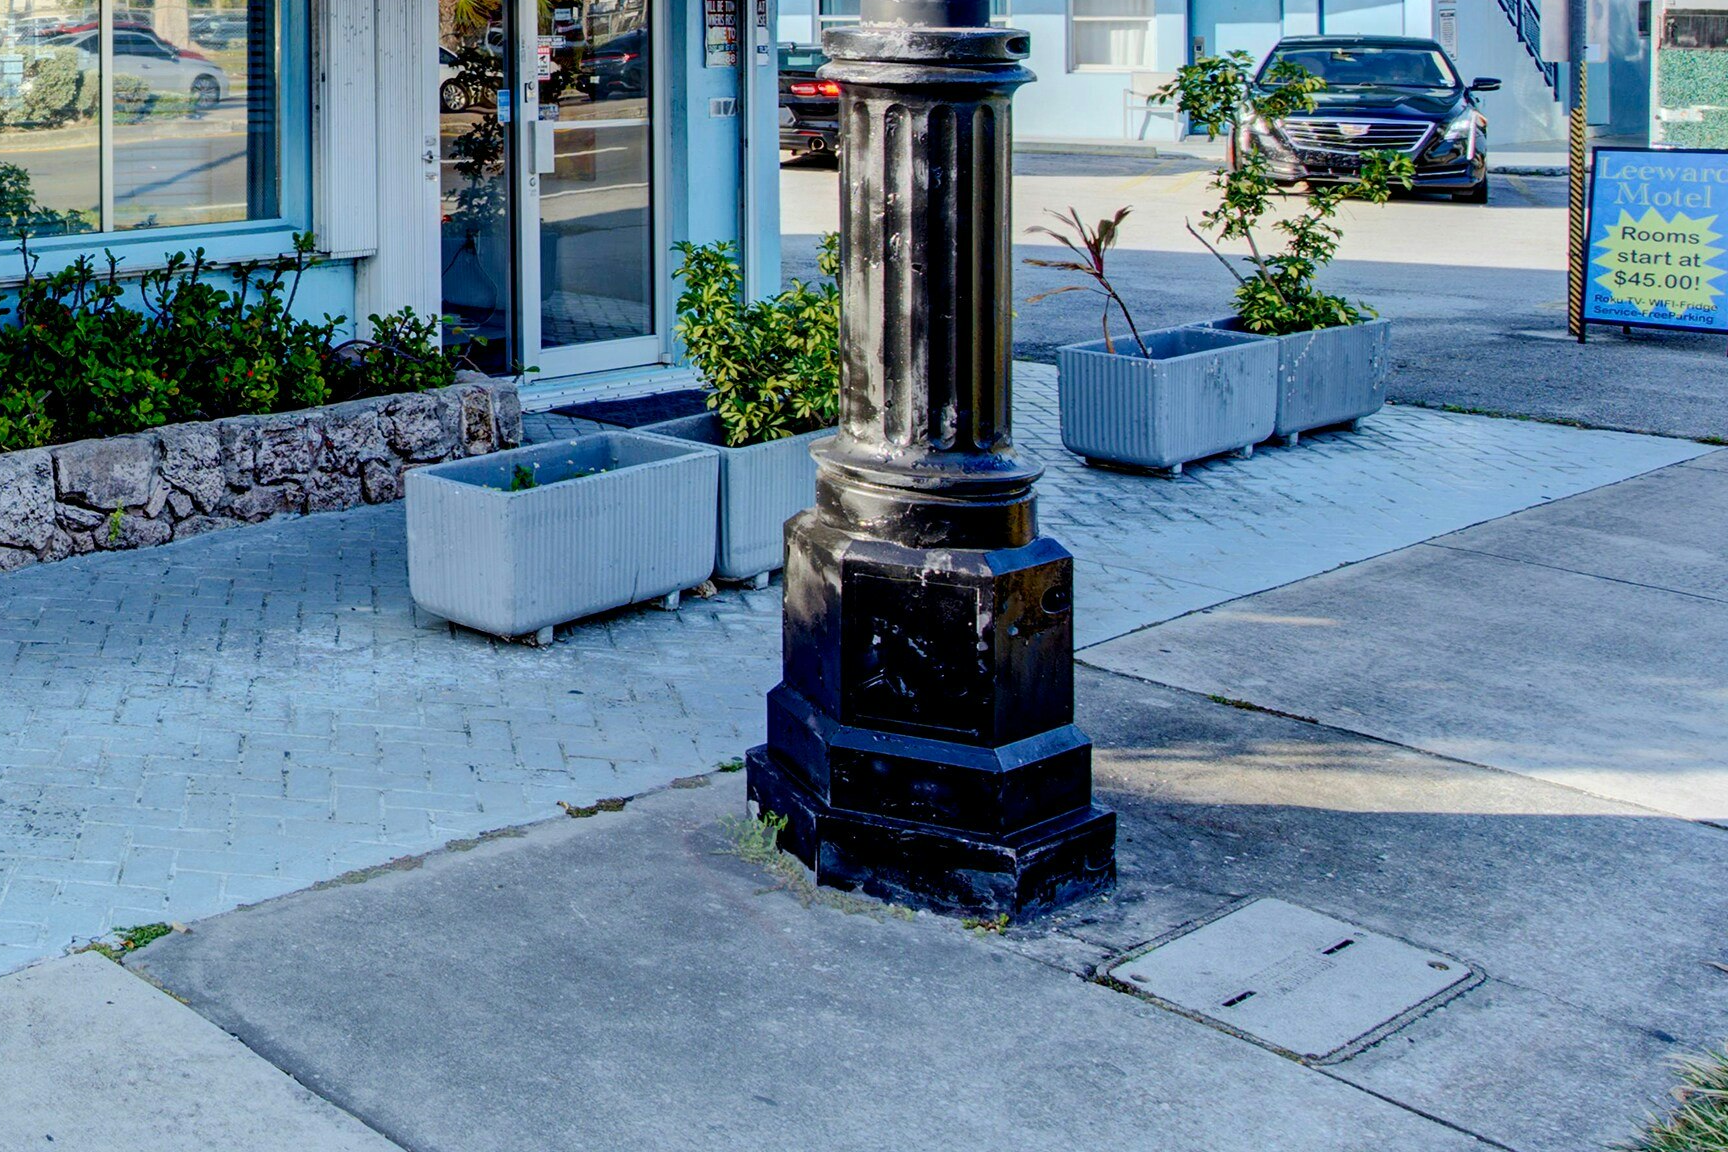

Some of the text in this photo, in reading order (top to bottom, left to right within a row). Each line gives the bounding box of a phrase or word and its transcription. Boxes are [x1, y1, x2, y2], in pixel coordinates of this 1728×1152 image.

[1613, 181, 1713, 209] Motel
[1621, 226, 1700, 245] Rooms
[1617, 250, 1702, 268] start at
[1614, 269, 1700, 291] $45.00!
[1594, 294, 1624, 305] Roku
